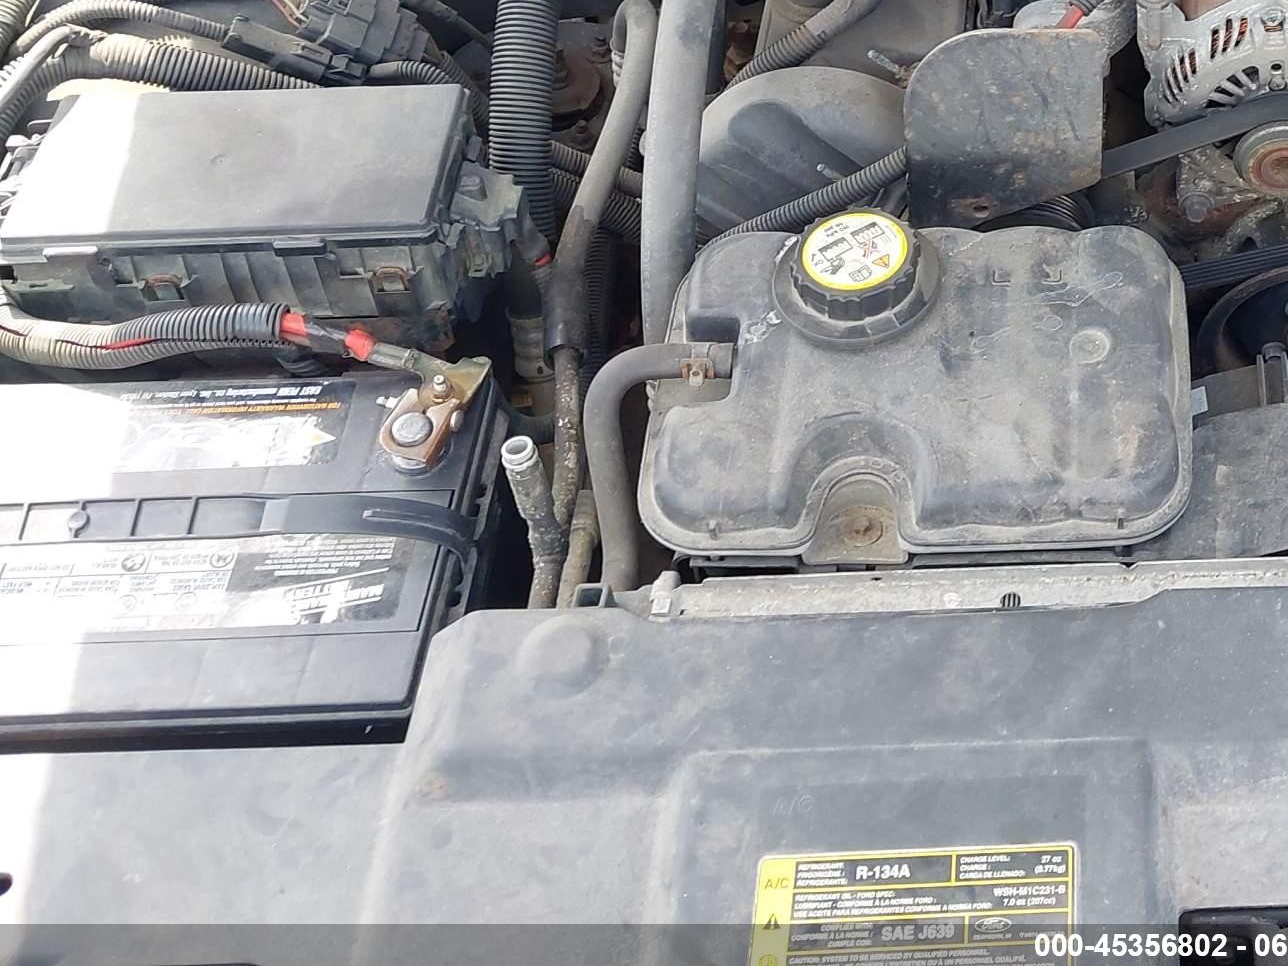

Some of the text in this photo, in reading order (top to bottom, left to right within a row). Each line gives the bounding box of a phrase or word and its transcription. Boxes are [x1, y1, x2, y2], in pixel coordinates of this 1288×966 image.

[856, 864, 911, 880] R-134A
[764, 877, 790, 890] A/C
[880, 924, 955, 942] SAE J639
